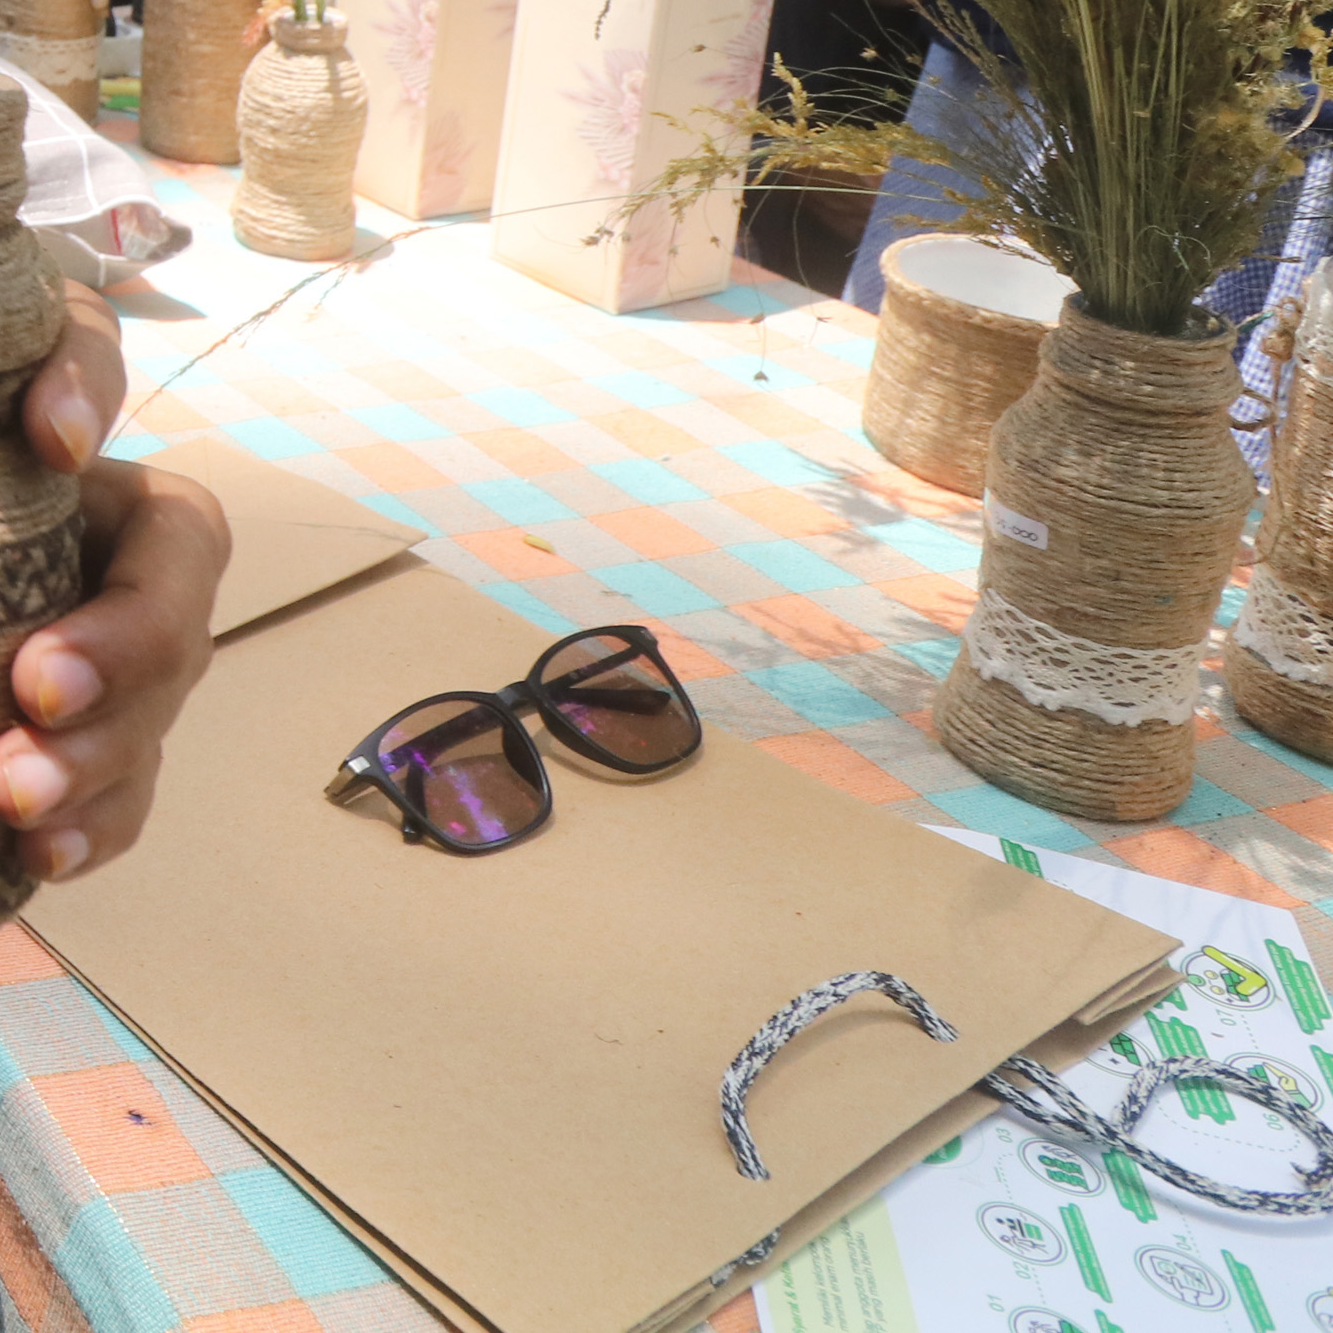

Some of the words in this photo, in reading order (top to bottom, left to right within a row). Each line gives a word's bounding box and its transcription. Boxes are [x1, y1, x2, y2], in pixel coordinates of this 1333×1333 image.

[1215, 1008, 1237, 1027] 07
[1263, 1112, 1284, 1131] 06
[995, 1127, 1013, 1143] 03
[1172, 1233, 1192, 1252] 04
[1013, 1261, 1031, 1280] 02
[987, 1294, 1005, 1312] 01
